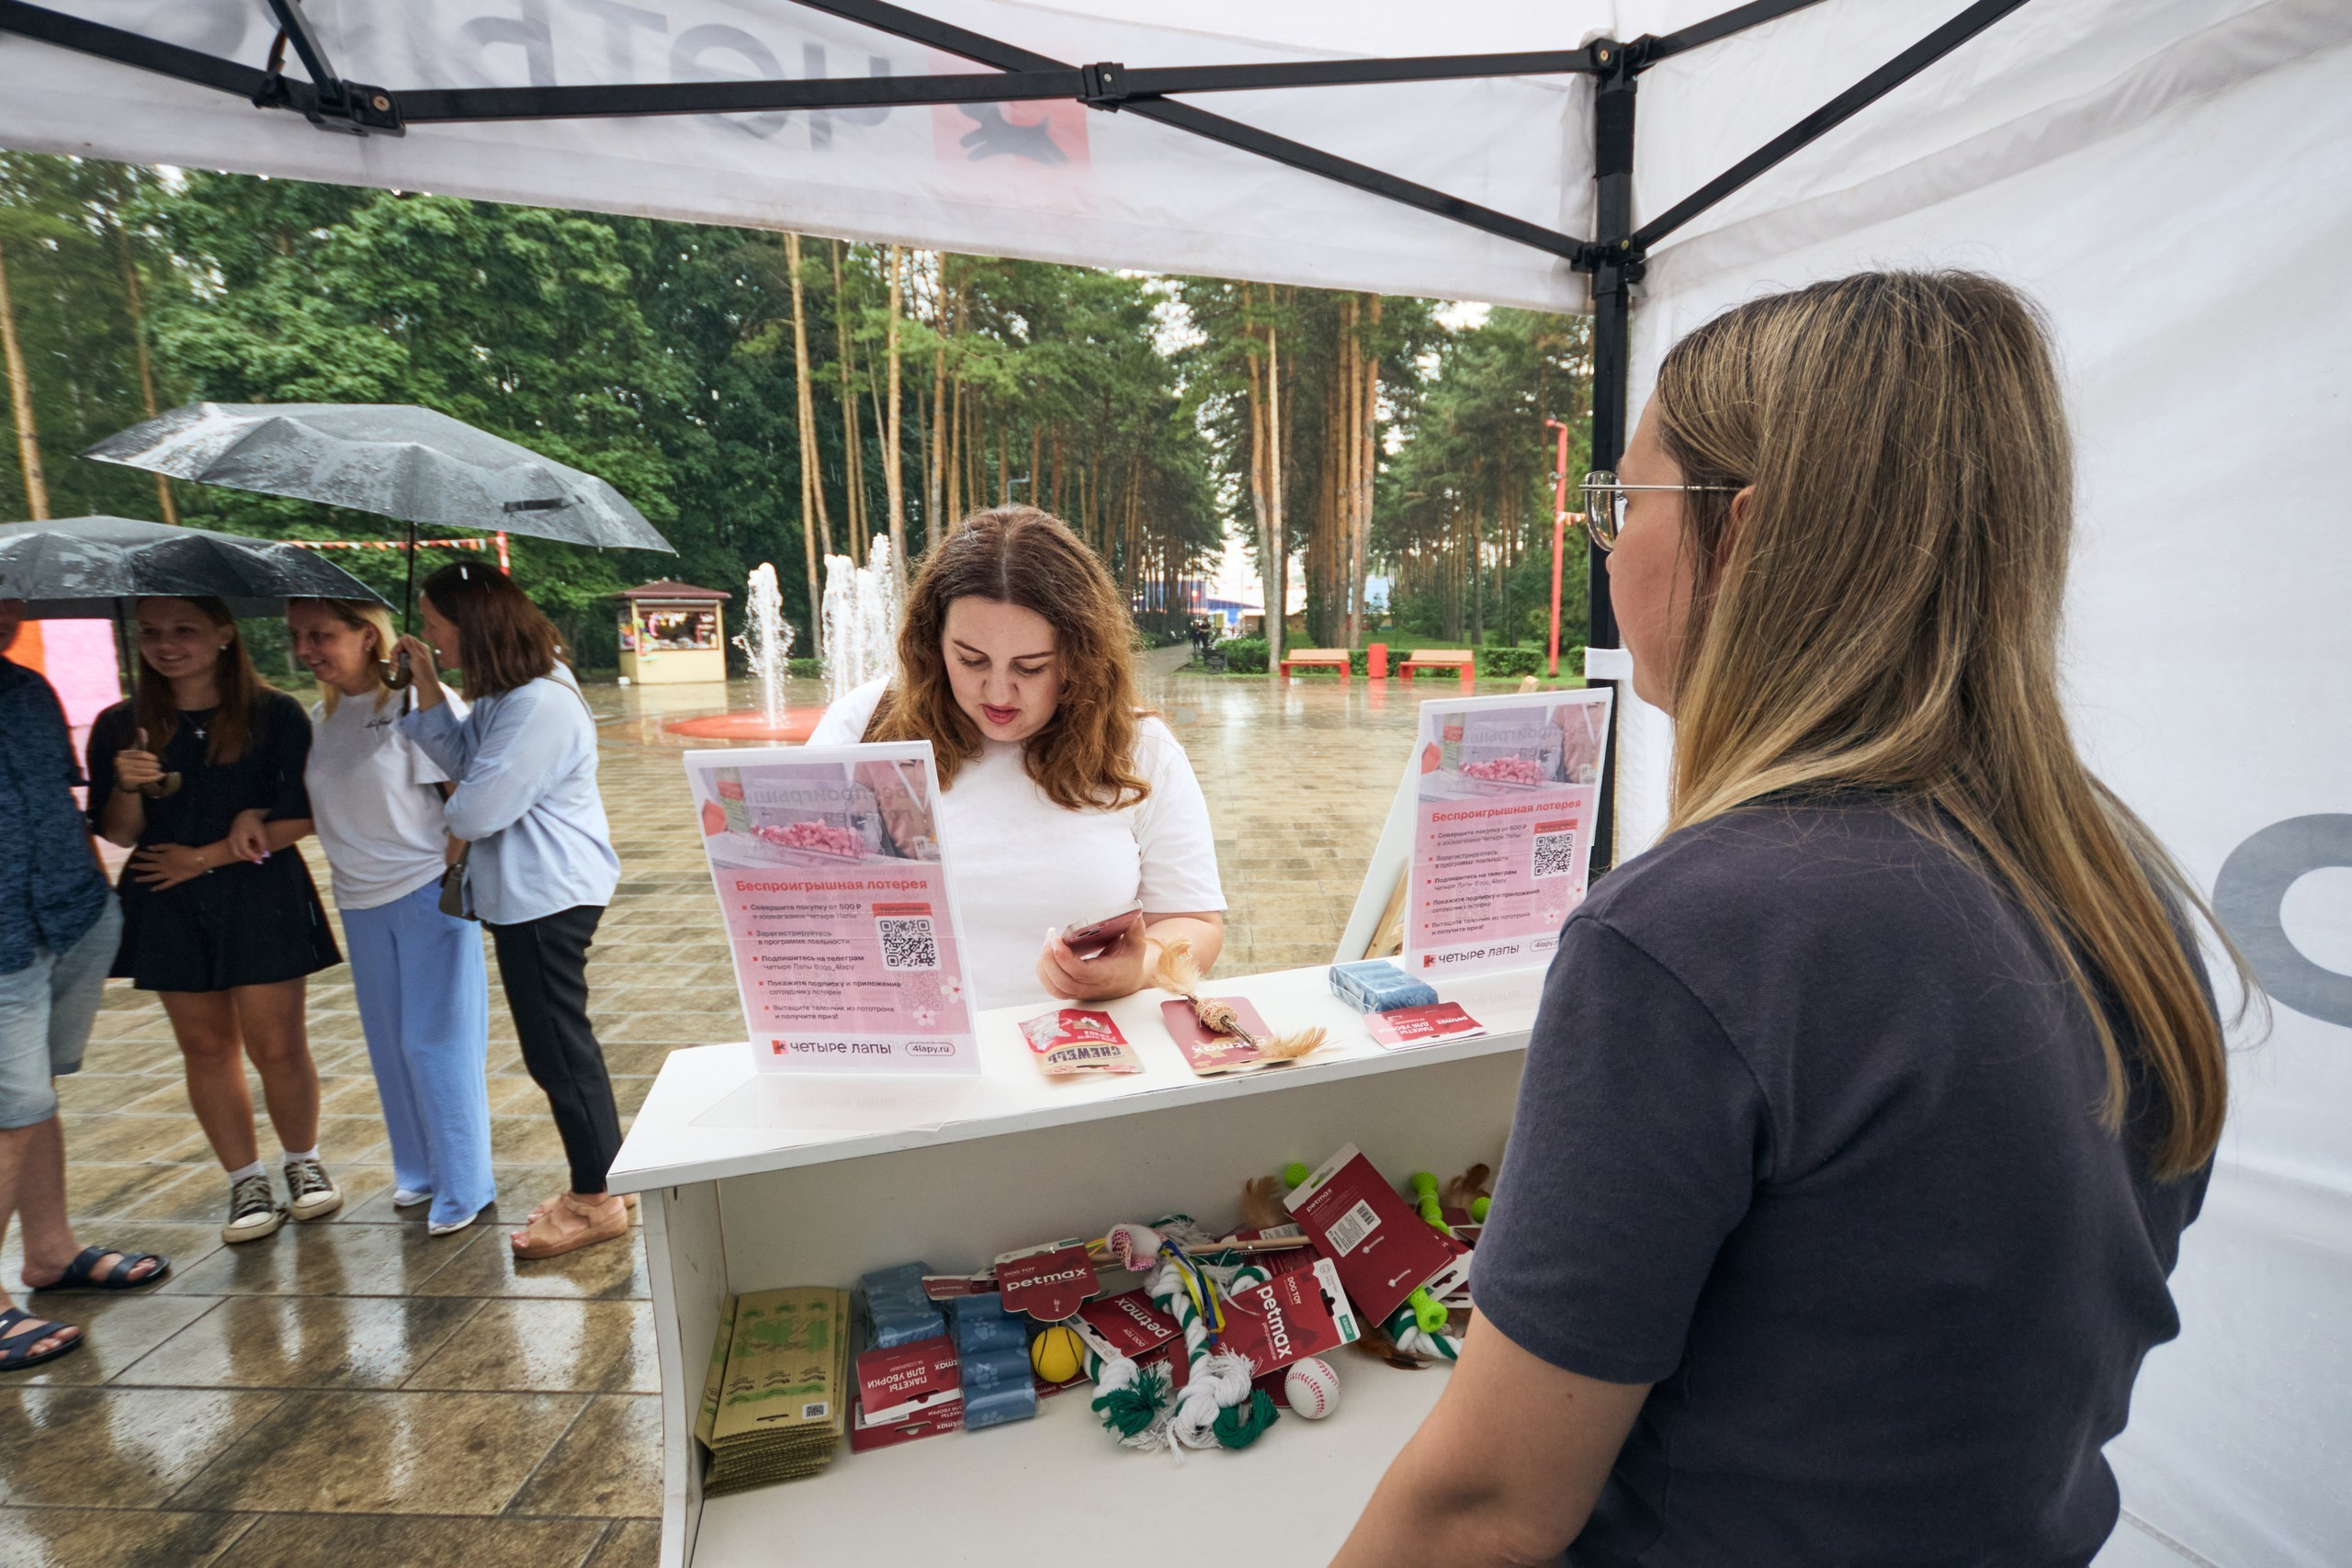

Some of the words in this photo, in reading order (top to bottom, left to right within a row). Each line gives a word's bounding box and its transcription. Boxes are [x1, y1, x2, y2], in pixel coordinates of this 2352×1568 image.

[1431, 805, 1533, 823] Беспроигрышная
[1535, 799, 1581, 812] лотерея
[1438, 830, 1475, 839] Совершите
[1476, 828, 1500, 837] покупку
[1436, 849, 1498, 862] Зарегистрируйтесь
[1440, 860, 1475, 870] программе
[1476, 856, 1510, 865] лояльности
[1434, 874, 1477, 884] Подпишитесь
[735, 880, 864, 893] Беспроигрышная
[866, 880, 928, 891] лотерея
[1433, 897, 1464, 906] Покажите
[1465, 894, 1496, 903] подписку
[1501, 889, 1540, 899] приложение
[796, 904, 828, 912] покупку
[1431, 919, 1463, 929] Вытащите
[755, 930, 832, 939] Зарегистрируйтесь
[1437, 927, 1466, 936] получите
[1467, 924, 1484, 932] приз!
[764, 939, 806, 947] программе
[1534, 938, 1558, 949] 4lapy.r
[762, 955, 815, 964] Подпишитесь
[763, 964, 792, 973] Четыре
[814, 964, 854, 973] @zoo_4lapy
[808, 981, 844, 989] подписку
[1436, 1015, 1468, 1025] petmax
[1400, 1026, 1434, 1035] ПАКЕТЫ
[912, 1044, 949, 1055] 4lapy.ru
[1306, 1188, 1333, 1213] petmax
[1007, 1268, 1087, 1292] petmax
[1287, 1276, 1296, 1292] DOG
[1292, 1292, 1302, 1304] TOY
[1114, 1298, 1172, 1338] petmax
[1257, 1285, 1293, 1359] petmax
[1123, 1328, 1134, 1338] TOY
[1132, 1337, 1146, 1347] DOG
[934, 1359, 958, 1371] tmax
[907, 1366, 925, 1378] ДЛЯ
[867, 1373, 905, 1389] УБОРКИ
[889, 1376, 927, 1393] ПАКЕТЫ
